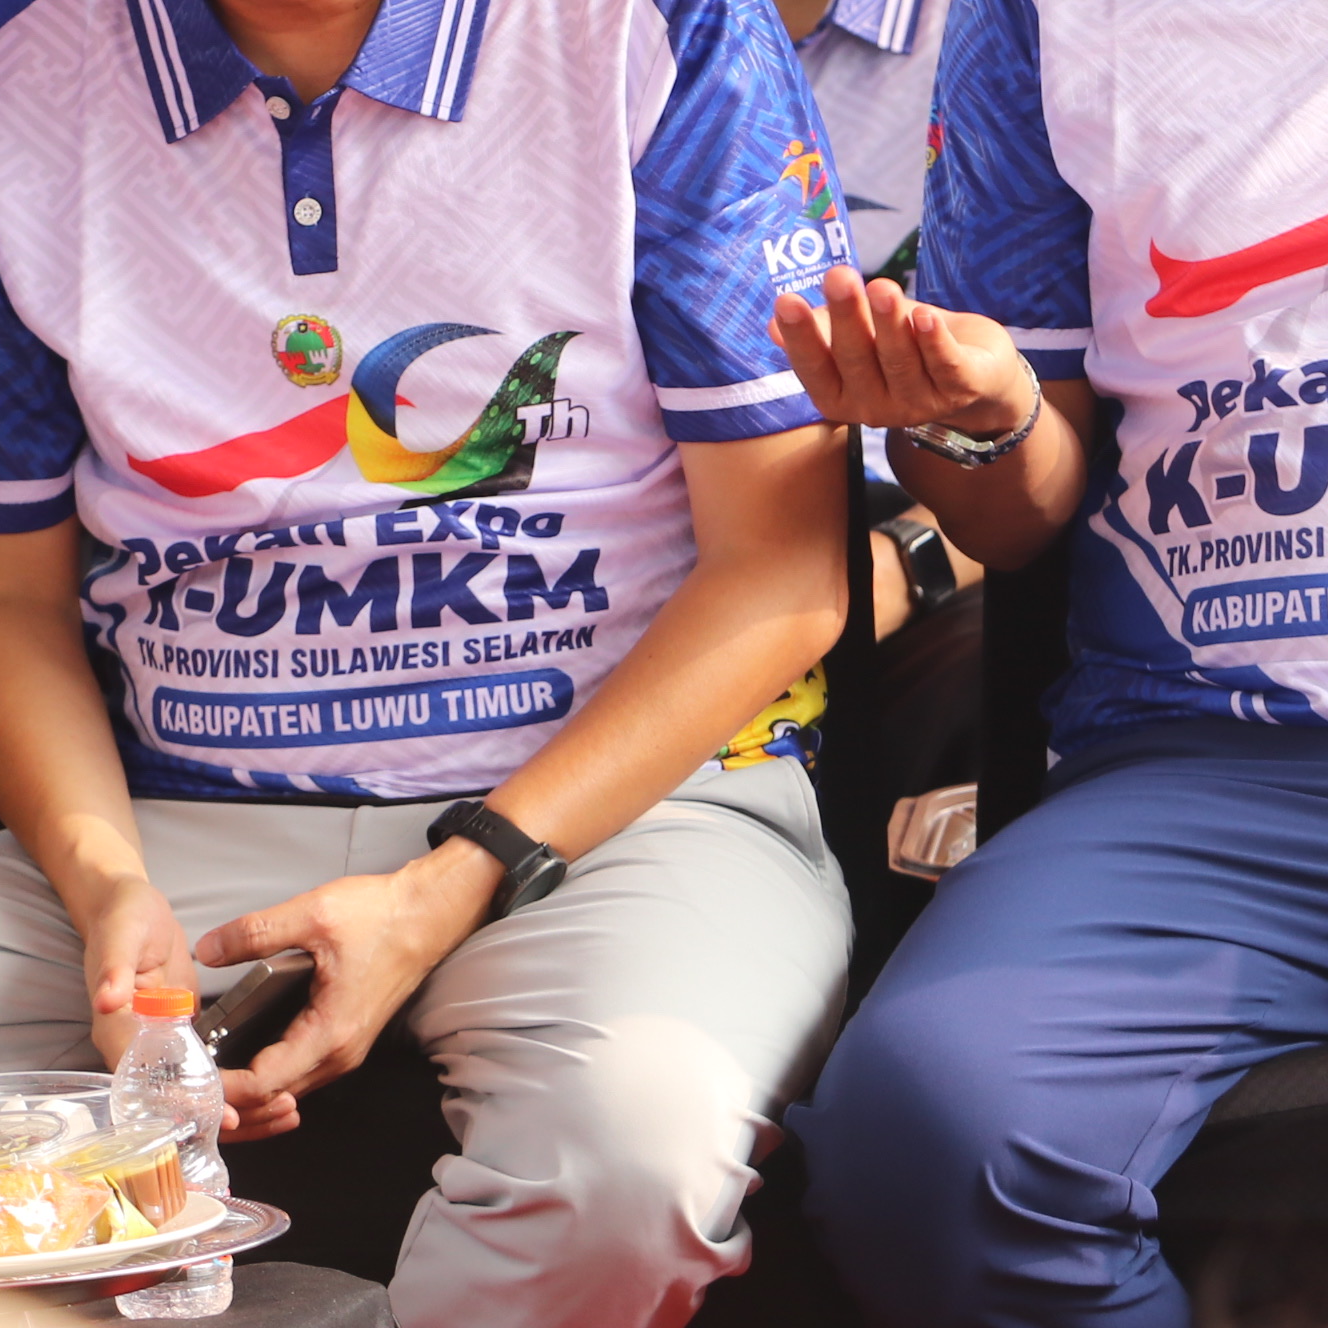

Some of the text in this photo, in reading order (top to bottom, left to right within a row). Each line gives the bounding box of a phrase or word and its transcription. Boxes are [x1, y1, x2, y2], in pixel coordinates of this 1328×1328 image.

[375, 500, 566, 550] Expo
[1167, 526, 1326, 579] TK.PROVINSI
[138, 624, 598, 679] TK.PROVINSI SULAWESI SELATAN
[160, 681, 557, 738] KABUPATEN LUWU TIMUR
